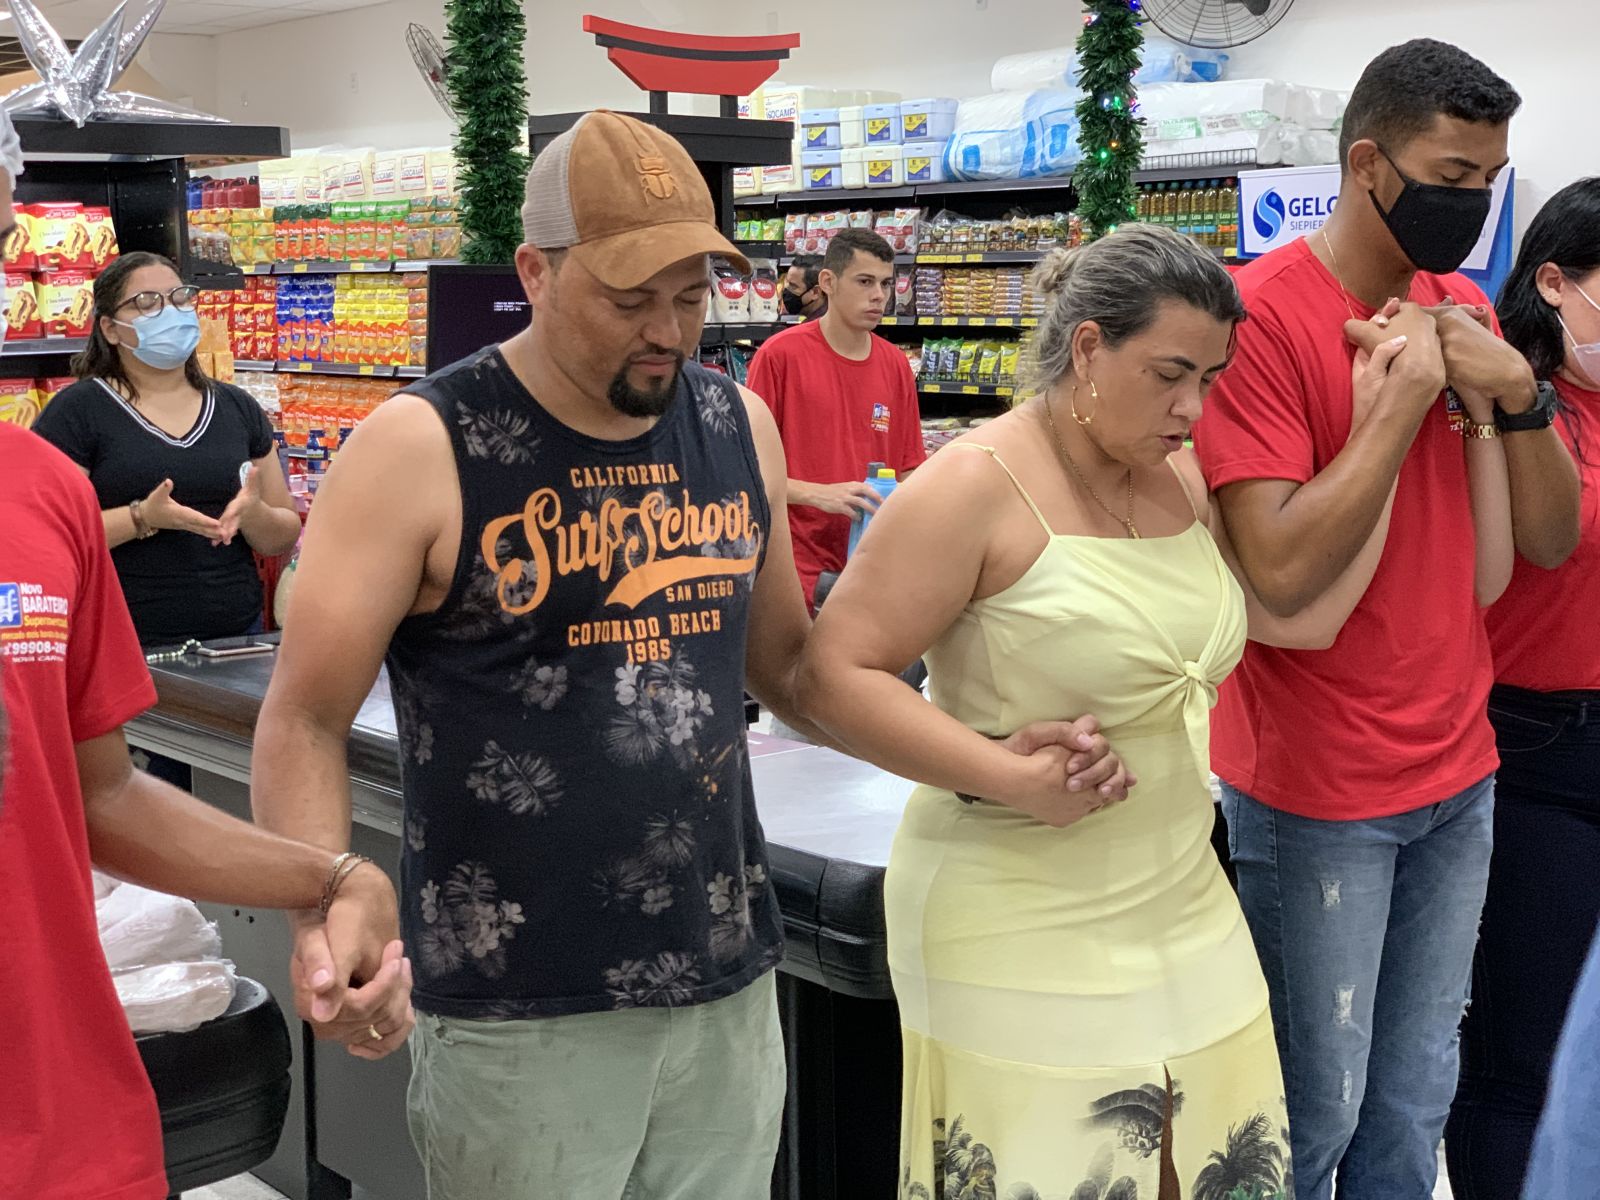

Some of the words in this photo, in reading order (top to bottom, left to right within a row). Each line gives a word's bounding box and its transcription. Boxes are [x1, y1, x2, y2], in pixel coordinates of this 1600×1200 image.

[569, 463, 680, 489] CALIFORNIA
[481, 487, 623, 615] Surf
[625, 488, 759, 572] School
[665, 585, 693, 602] SAN
[697, 579, 735, 600] DIEGO
[668, 609, 722, 636] BEACH
[625, 637, 672, 664] 1985
